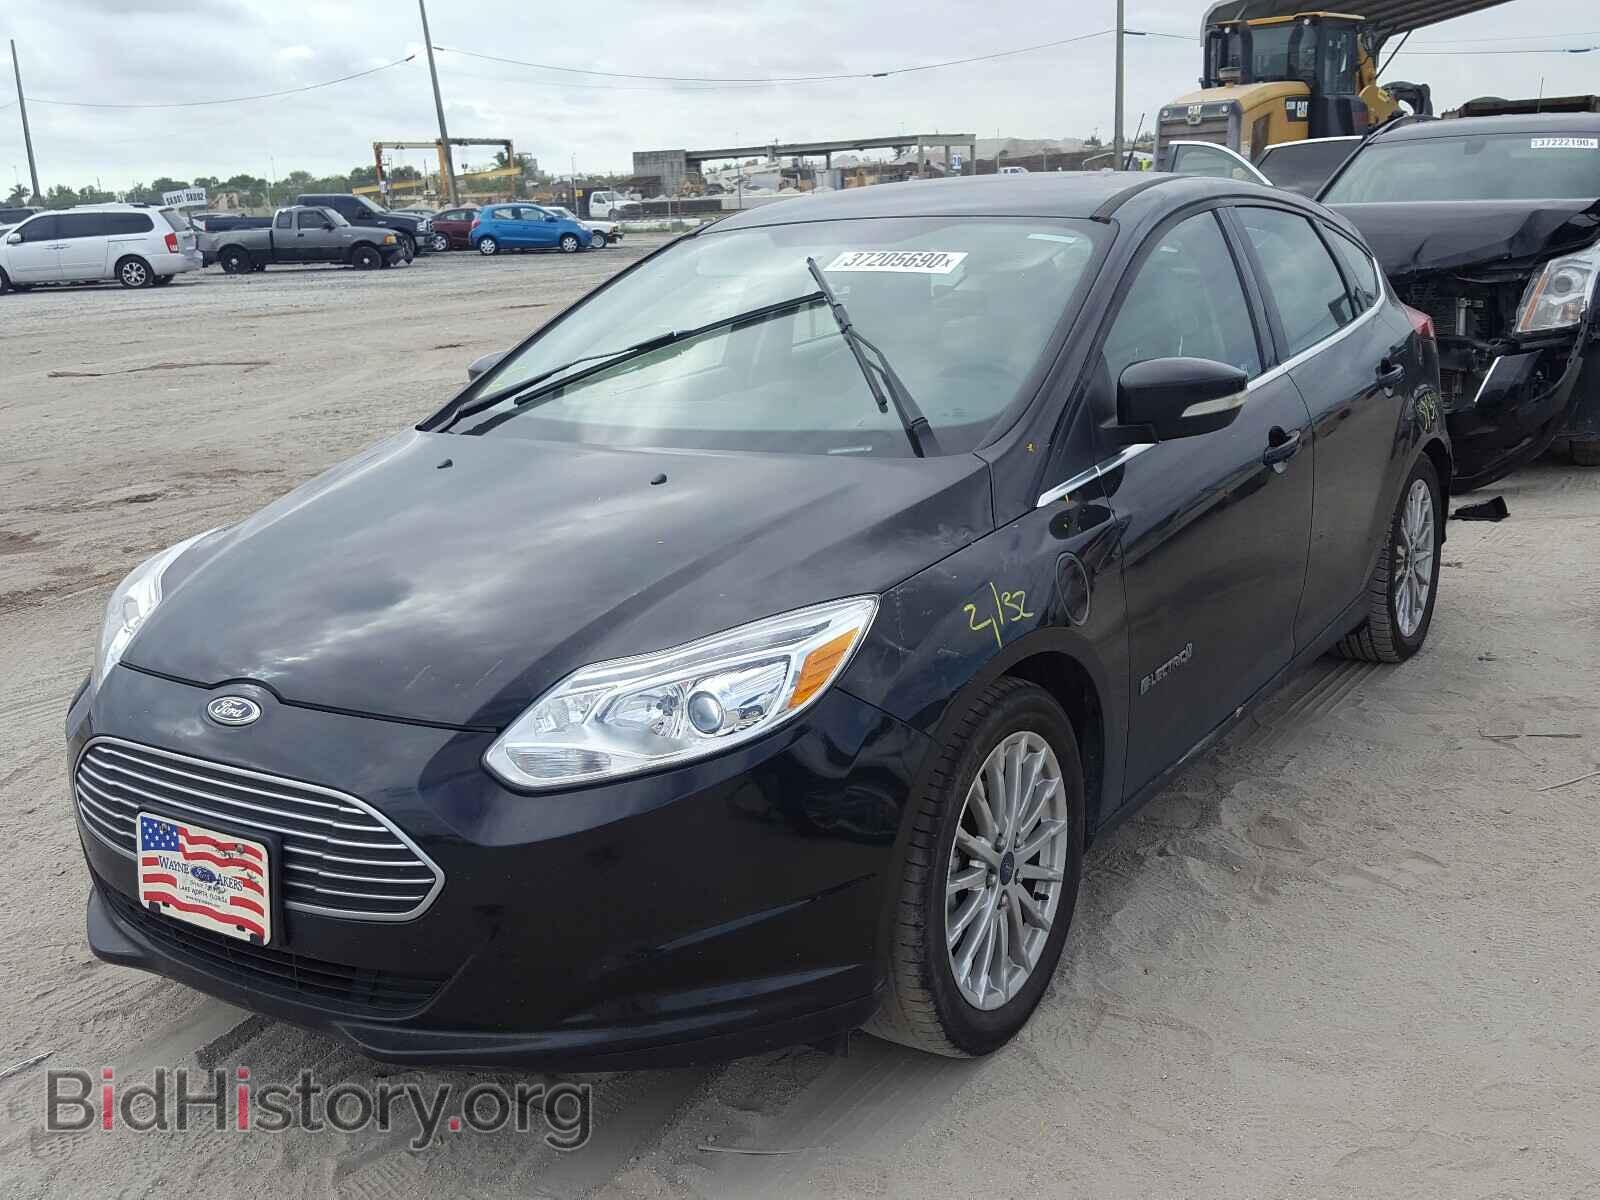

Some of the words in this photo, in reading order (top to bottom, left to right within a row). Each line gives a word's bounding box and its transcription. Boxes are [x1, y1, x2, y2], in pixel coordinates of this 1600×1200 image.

[1188, 104, 1202, 114] CAT
[214, 699, 247, 717] Ford
[158, 856, 189, 874] WAYNE
